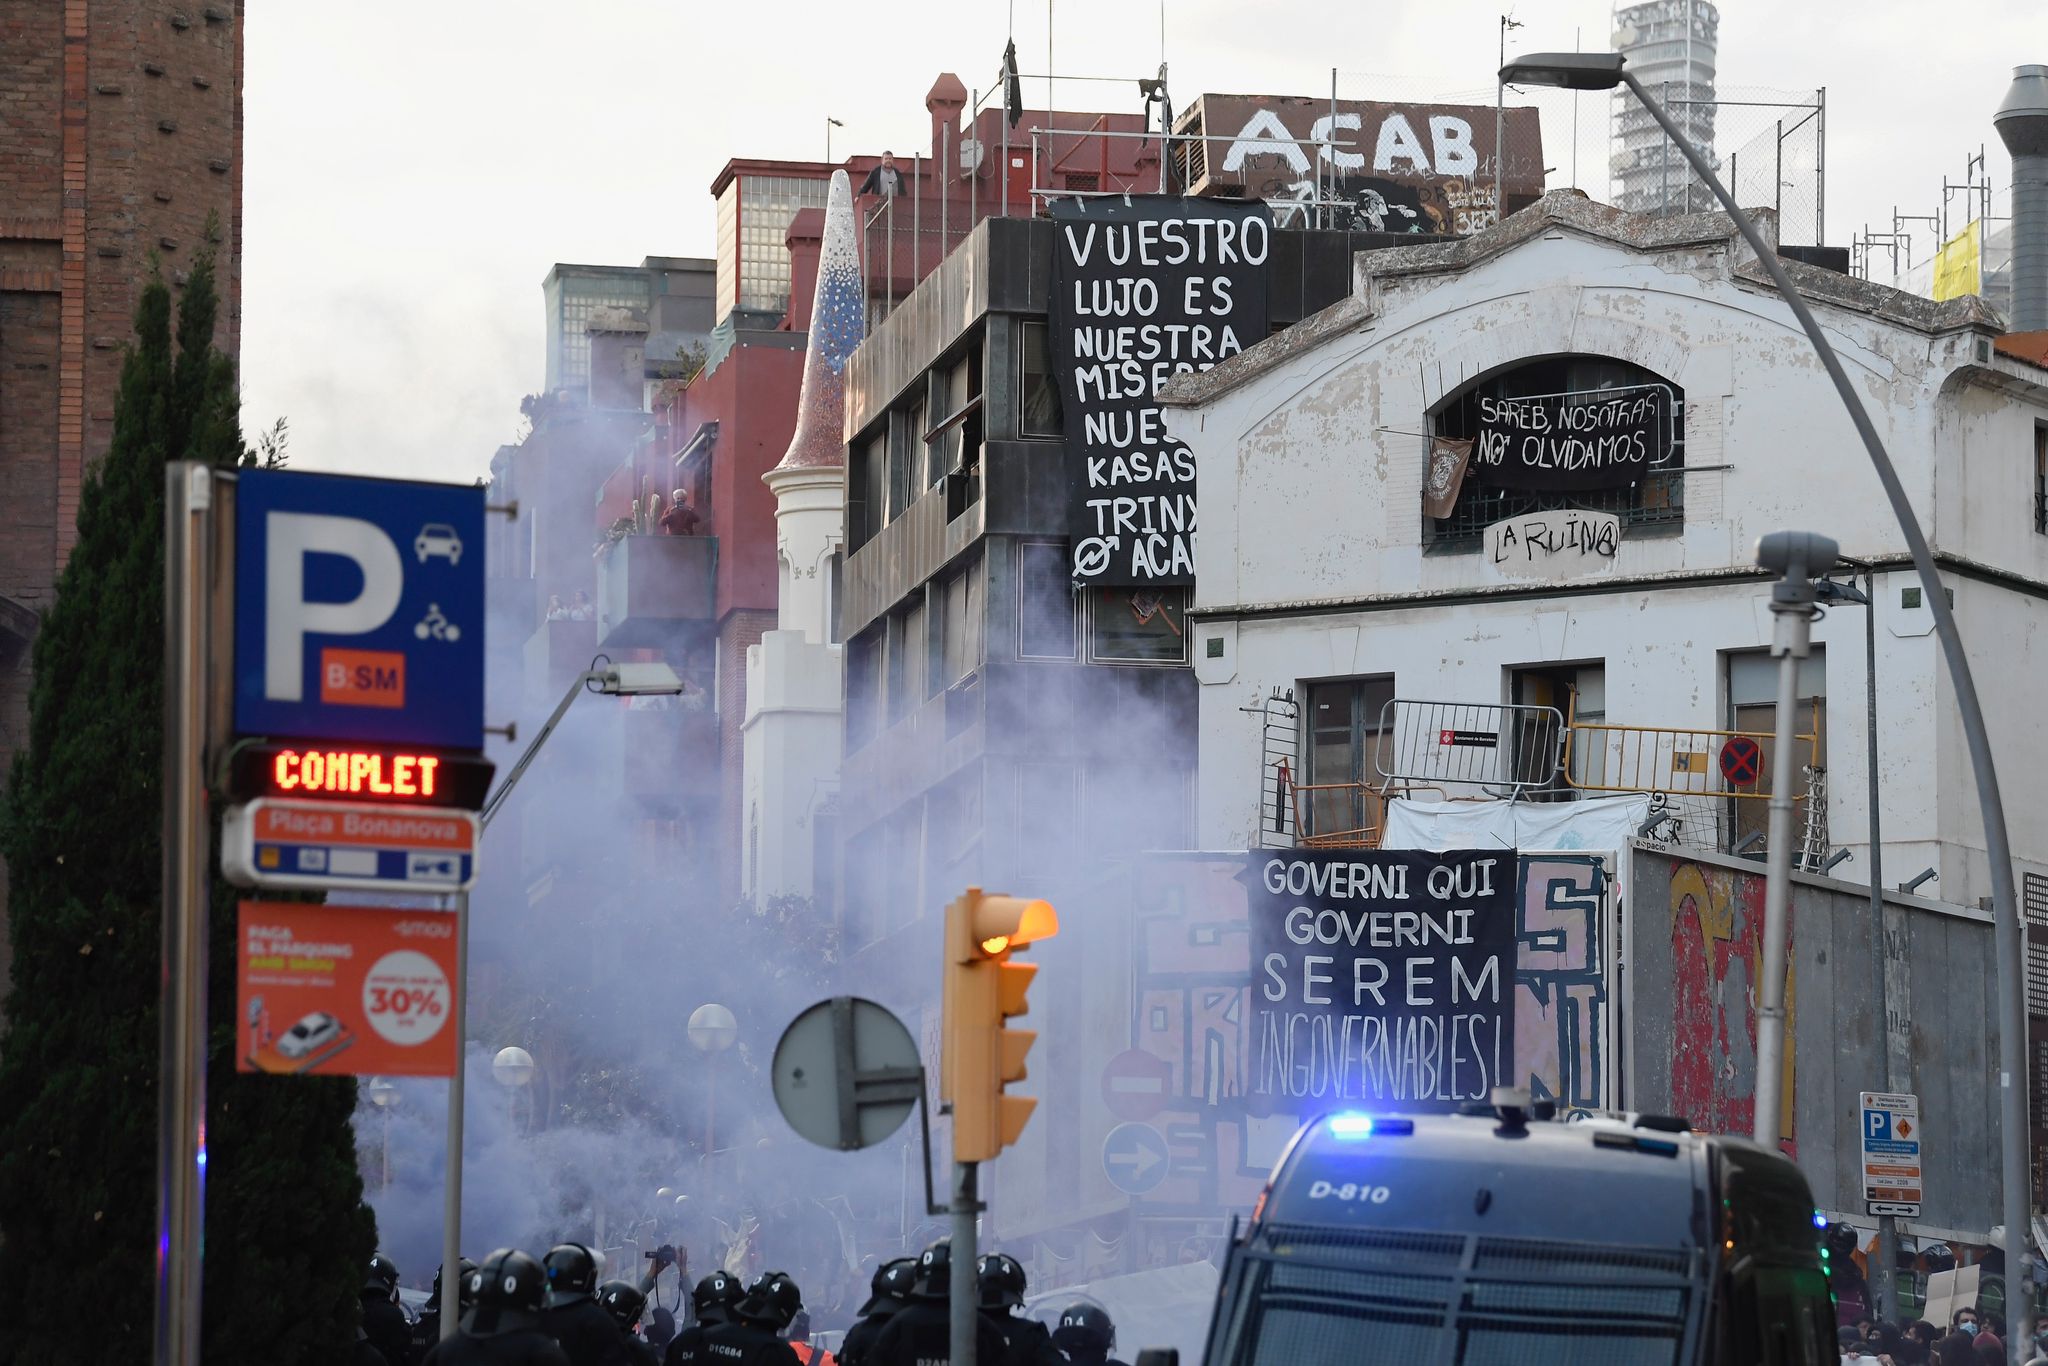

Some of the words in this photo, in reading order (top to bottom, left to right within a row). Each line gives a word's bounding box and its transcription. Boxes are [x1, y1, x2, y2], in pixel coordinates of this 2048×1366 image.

[1222, 108, 1478, 175] ACAB
[1065, 216, 1268, 267] VUESTRO
[1075, 278, 1158, 317] LUJO
[1184, 276, 1233, 316] ES
[1074, 324, 1242, 362] NUESTRA
[1075, 360, 1215, 402] MISE
[1087, 447, 1196, 488] KASAS
[1522, 431, 1646, 471] OLVIDAMOS
[1132, 533, 1197, 578] ACA
[1495, 525, 1517, 563] LA
[265, 511, 404, 702] P
[276, 750, 438, 795] COMPLET
[269, 811, 333, 834] Plaça
[343, 813, 458, 840] Bonanova
[1263, 859, 1409, 899] GOVERNI
[1427, 859, 1497, 900] QUI
[1285, 906, 1475, 947] GOVERNI
[1263, 953, 1500, 1006] SEREM
[369, 987, 442, 1017] 30%
[1255, 1010, 1500, 1101] INGOVERNABLES!
[1870, 1112, 1885, 1137] P
[1309, 1181, 1390, 1204] D-810
[715, 1280, 724, 1290] D
[771, 1282, 780, 1292] 4
[888, 1269, 897, 1280] 4
[1002, 1263, 1010, 1274] 4
[608, 1292, 616, 1303] 4
